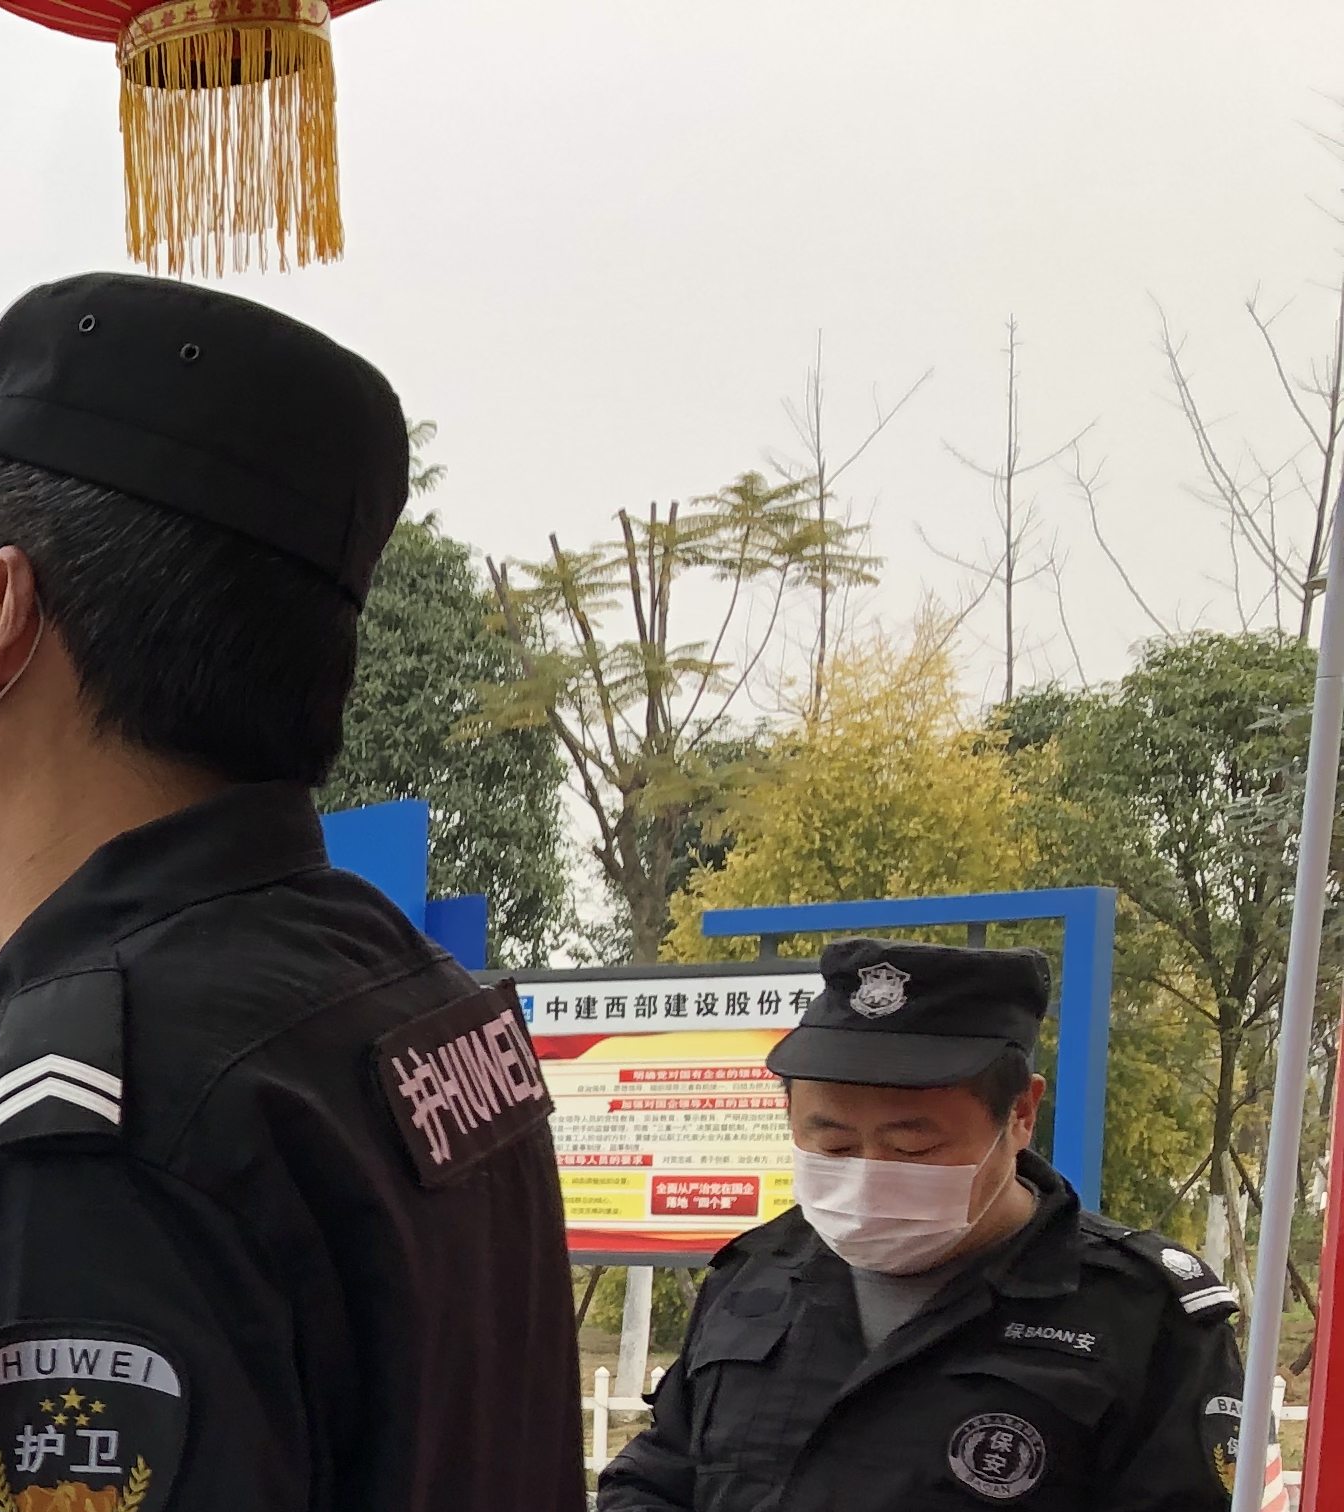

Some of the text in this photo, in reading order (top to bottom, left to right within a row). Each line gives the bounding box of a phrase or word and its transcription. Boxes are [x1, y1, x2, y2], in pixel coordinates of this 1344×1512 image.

[1, 1347, 157, 1384] HUWEI
[14, 1425, 123, 1475] 护卫
[982, 1430, 1014, 1475] 保安
